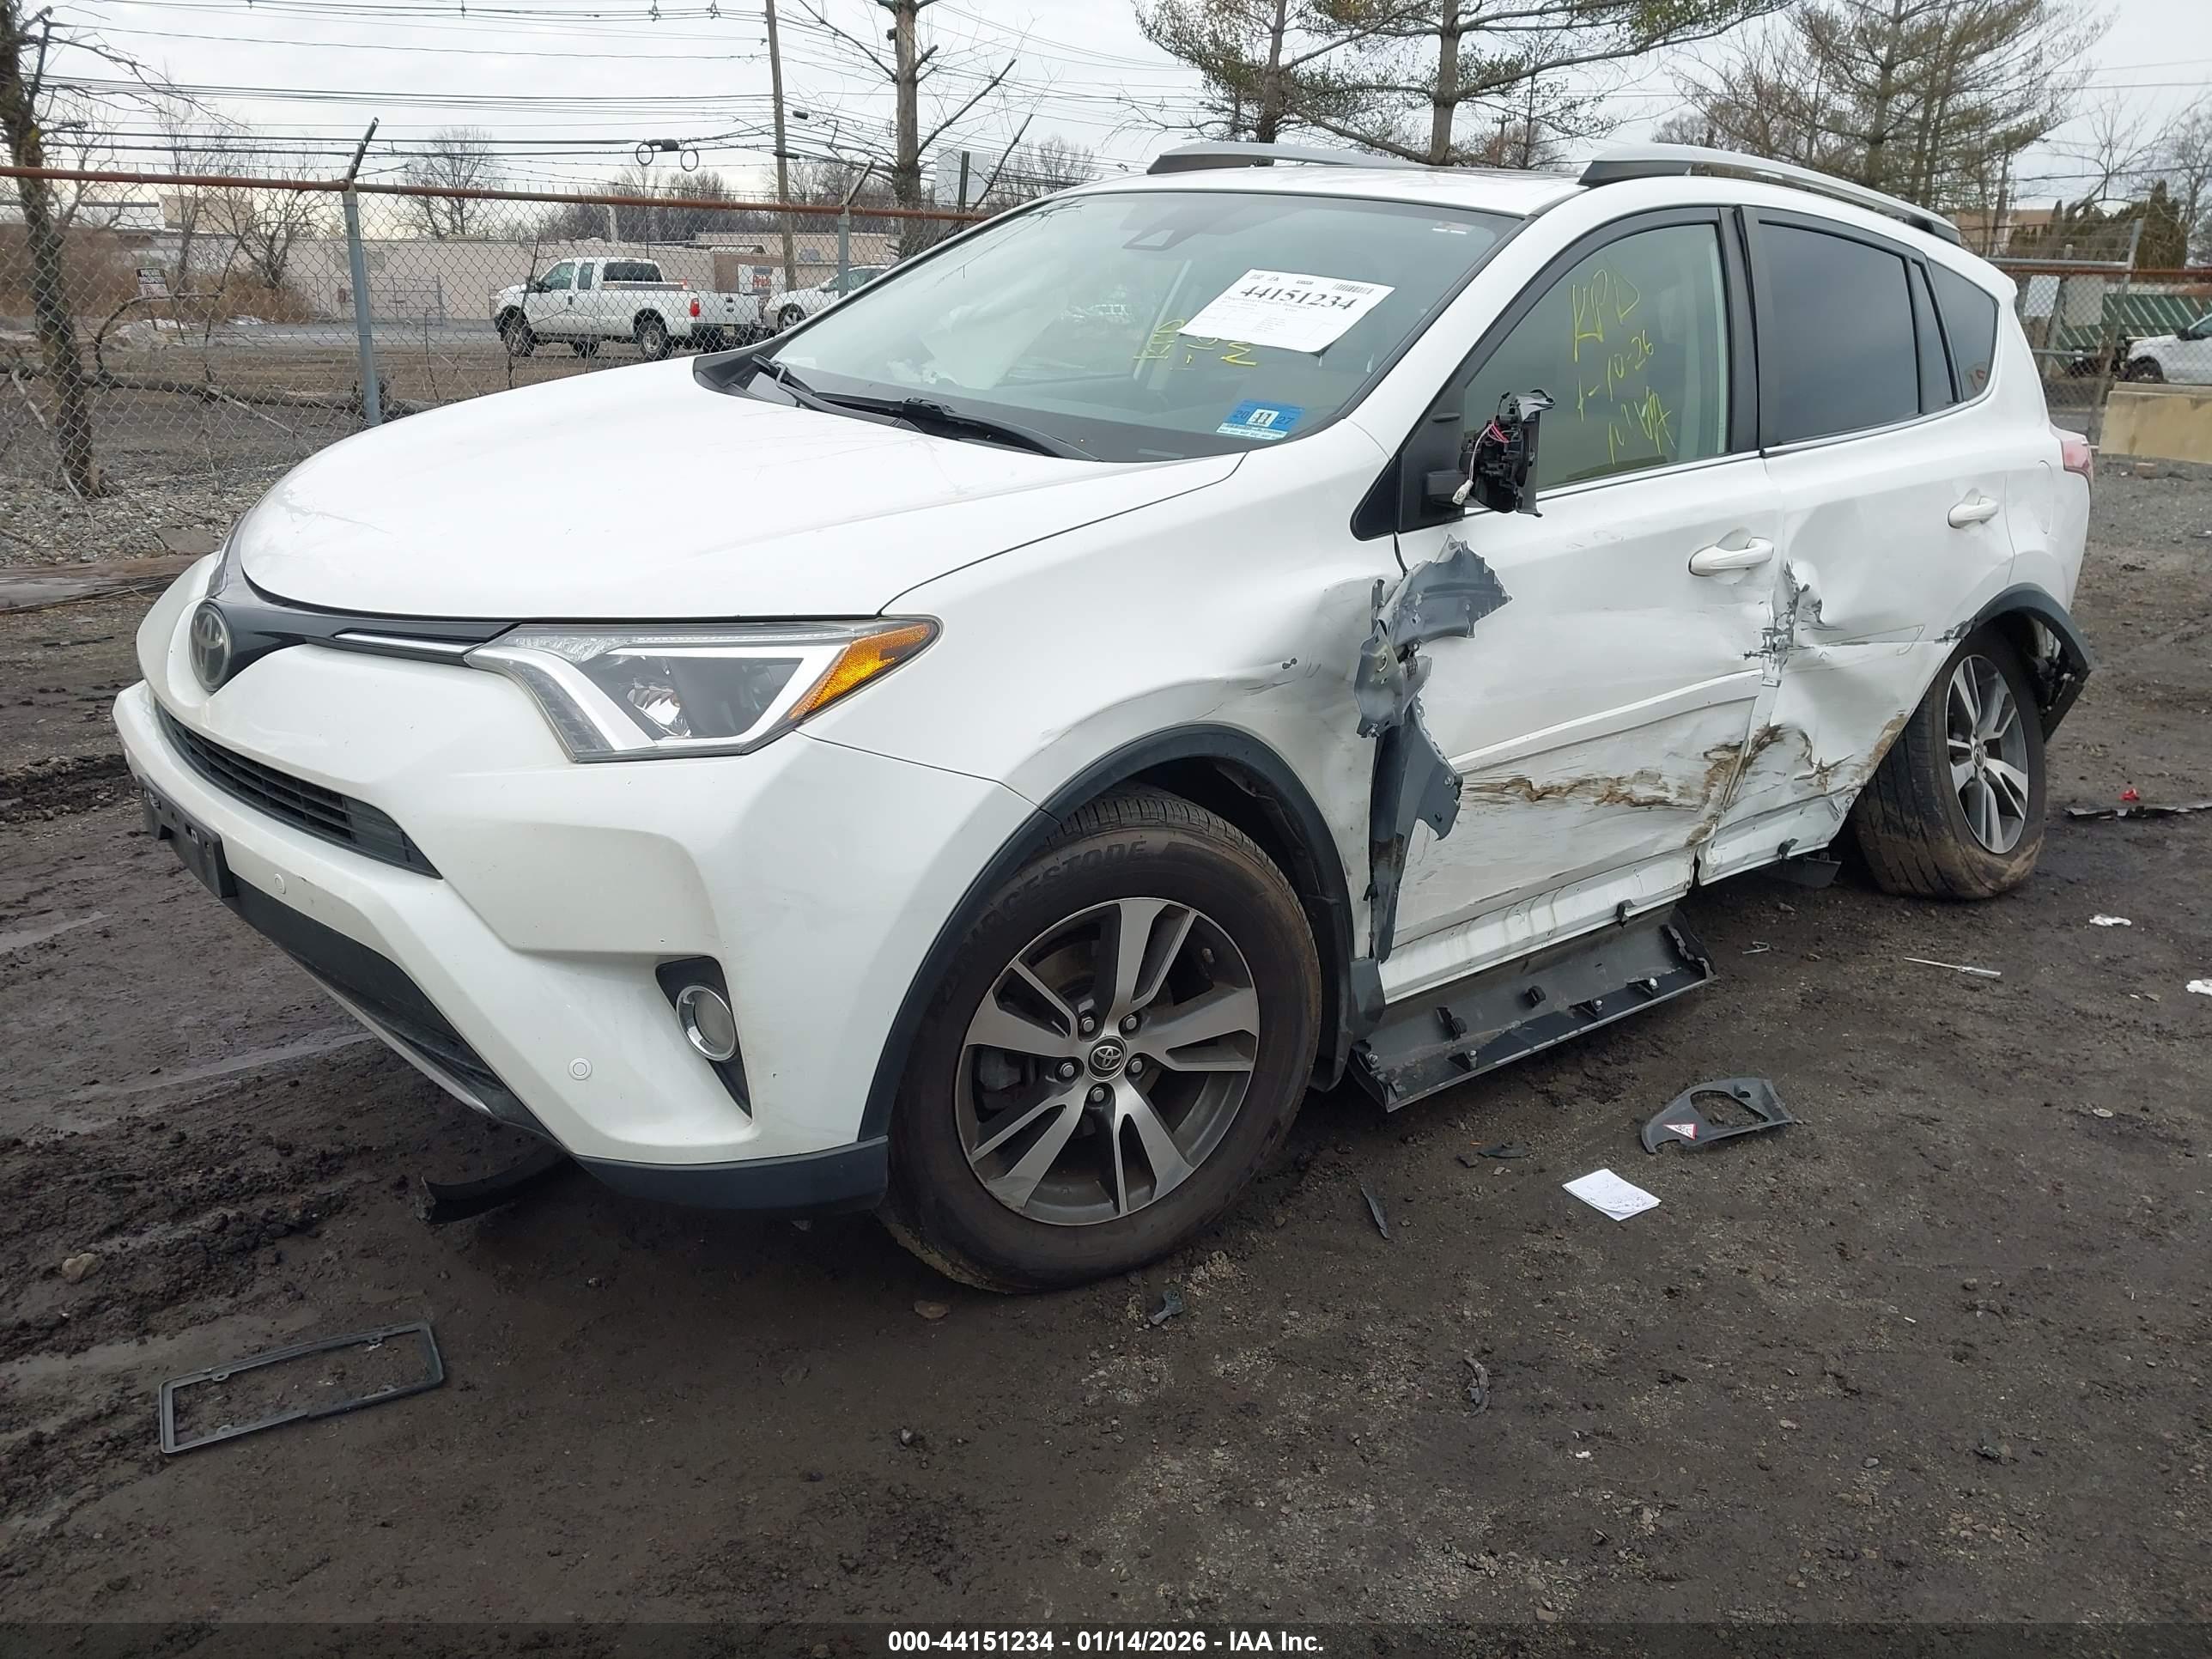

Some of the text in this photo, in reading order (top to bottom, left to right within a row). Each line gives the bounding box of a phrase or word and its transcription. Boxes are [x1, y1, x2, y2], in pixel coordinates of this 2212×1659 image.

[1241, 285, 1358, 310] 44151234
[1254, 411, 1273, 425] 11
[1275, 416, 1296, 425] 27
